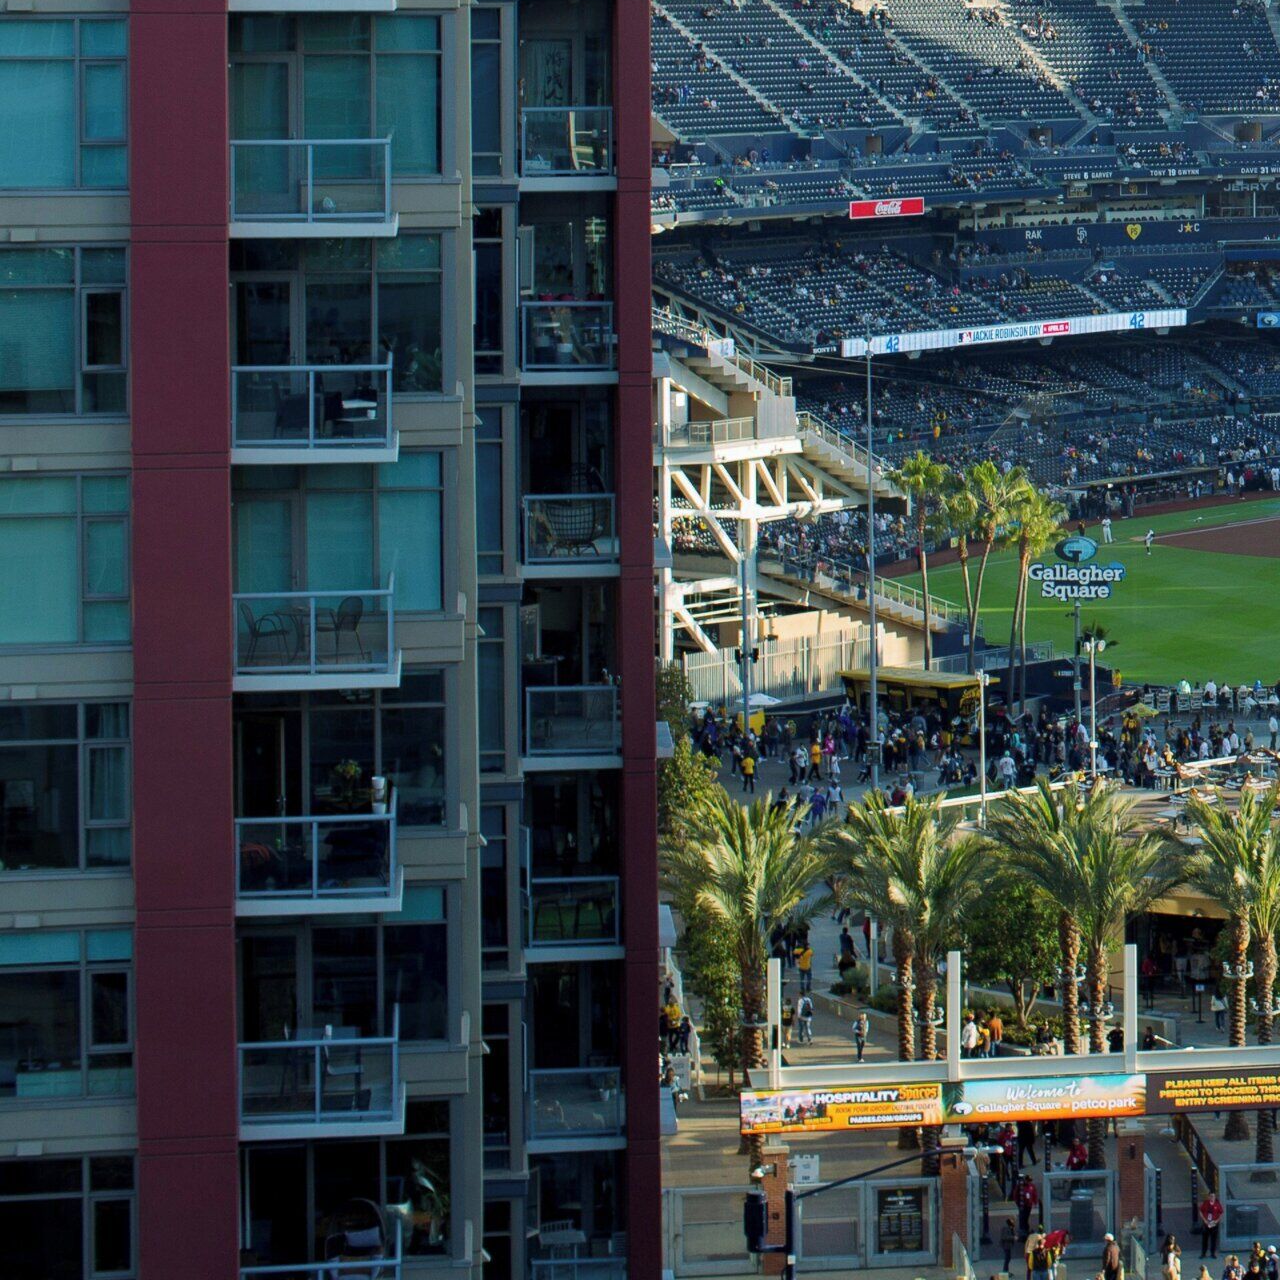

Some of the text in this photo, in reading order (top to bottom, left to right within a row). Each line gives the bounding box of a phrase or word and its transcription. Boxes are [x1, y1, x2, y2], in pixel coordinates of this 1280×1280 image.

[1064, 171, 1113, 180] STEVE 6 GARVEY
[1168, 168, 1176, 177] 19
[1260, 166, 1269, 174] 31
[1224, 182, 1270, 192] JERRY
[1025, 230, 1042, 240] RAK
[1129, 313, 1145, 328] 42
[972, 328, 994, 341] JACKIE
[995, 325, 1028, 340] ROBINSON
[1028, 324, 1042, 336] DAY
[886, 335, 900, 353] 42
[1028, 563, 1124, 585] Gallagher
[1041, 581, 1109, 601] Square
[1165, 1079, 1202, 1089] PLEASE
[1203, 1078, 1228, 1087] KEEP
[1230, 1077, 1246, 1086] ALL
[1248, 1076, 1277, 1085] ITEMS
[815, 1086, 938, 1105] HOSPITALITY Spaces
[1006, 1080, 1082, 1101] Welcome to
[1160, 1089, 1198, 1098] PERSON
[1199, 1088, 1212, 1097] TO
[1213, 1086, 1258, 1096] PROCEED
[975, 1102, 1025, 1114] Gallagher
[1026, 1101, 1062, 1112] Square
[1072, 1098, 1106, 1111] petco
[1108, 1096, 1137, 1110] park
[1175, 1097, 1206, 1107] ENTRY
[1207, 1095, 1262, 1105] SCREENING
